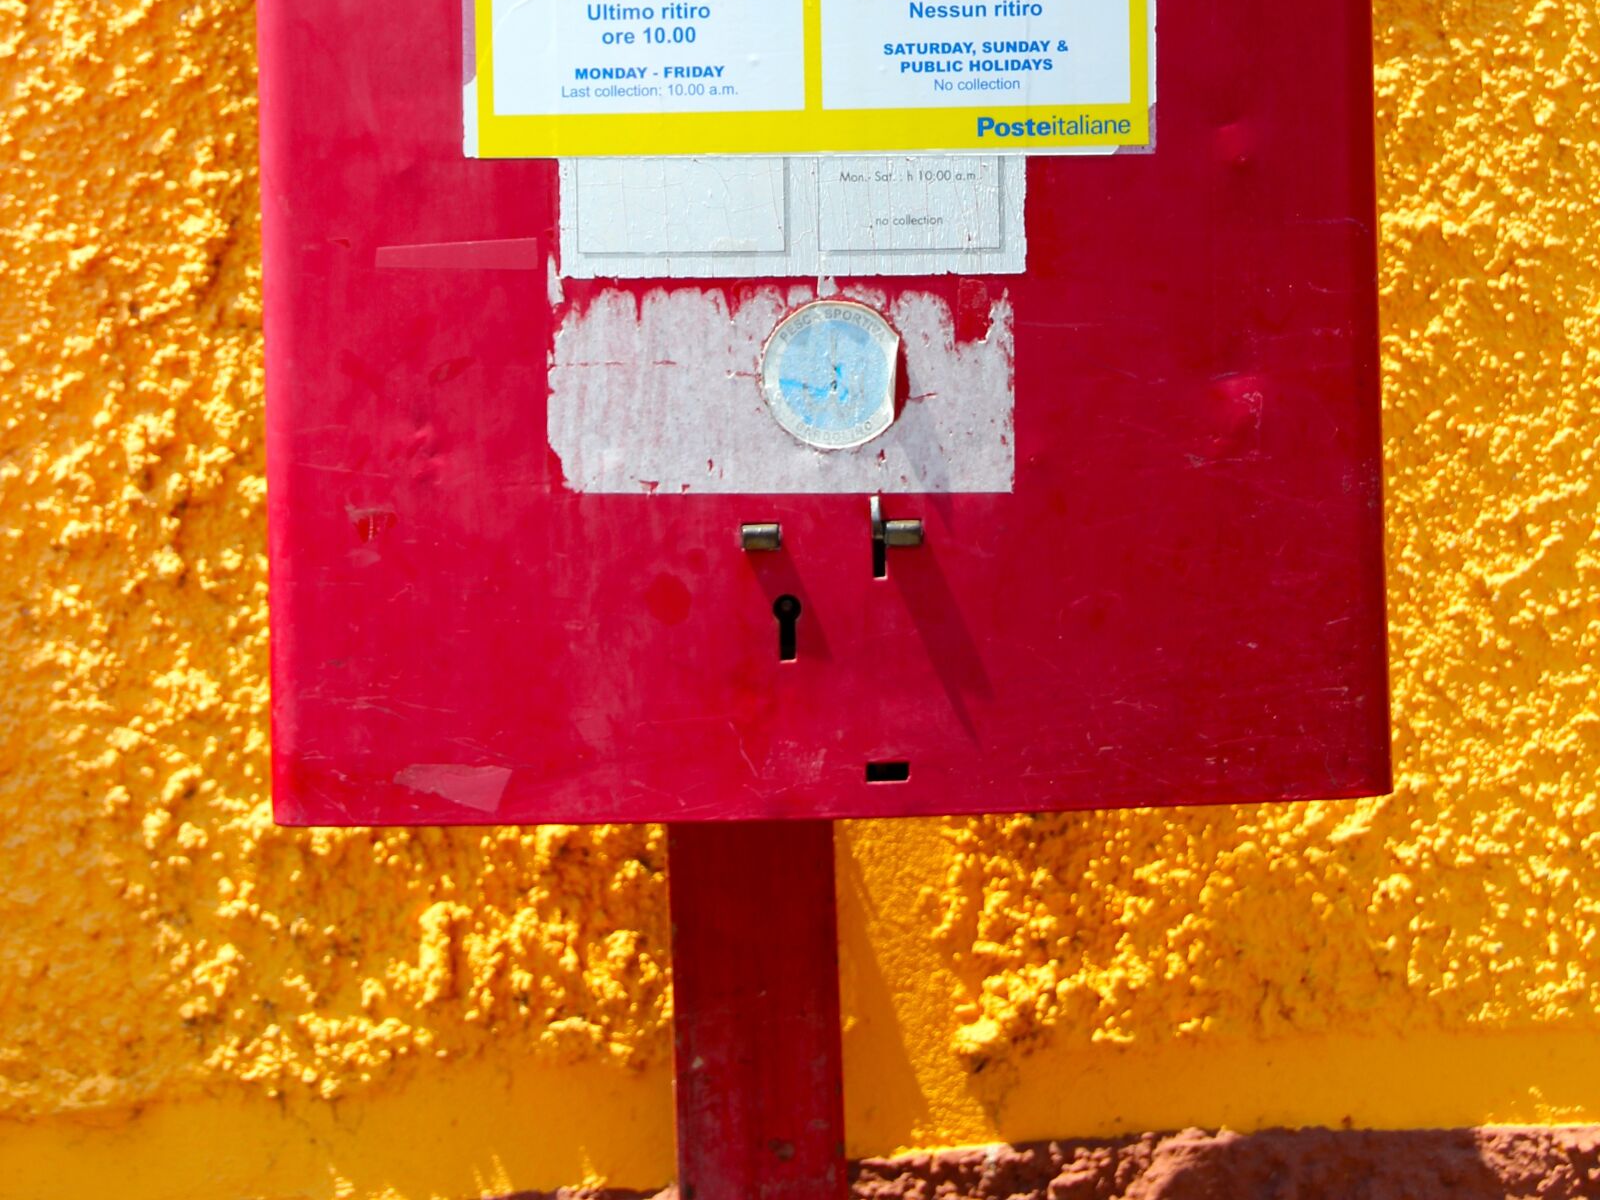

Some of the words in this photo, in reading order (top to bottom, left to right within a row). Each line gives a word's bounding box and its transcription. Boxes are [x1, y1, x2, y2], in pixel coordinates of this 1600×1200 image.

[587, 3, 655, 21] Ultimo
[661, 2, 711, 20] ritiro
[909, 2, 987, 19] Nessun
[994, 0, 1043, 17] ritiro
[602, 31, 635, 45] ore
[643, 26, 697, 44] 10.00
[883, 42, 977, 56] SATURDAY,
[981, 40, 1050, 54] SUNDAY
[1056, 40, 1069, 52] &
[574, 67, 648, 80] MONDAY
[663, 65, 725, 79] FRIDAY
[900, 61, 963, 73] PUBLIC
[968, 59, 1054, 72] HOLIDAYS
[561, 85, 590, 98] Last
[594, 84, 662, 97] collection:
[668, 83, 705, 96] 10.00
[709, 84, 739, 95] a.m.
[933, 78, 953, 91] No
[957, 77, 1021, 90] collection
[976, 115, 1131, 137] Posteitaliane
[906, 170, 914, 181] h
[919, 169, 952, 181] 10:00
[875, 216, 889, 226] no
[892, 214, 944, 226] collection
[780, 313, 819, 341] PESC
[824, 308, 886, 340] SPORTIVA
